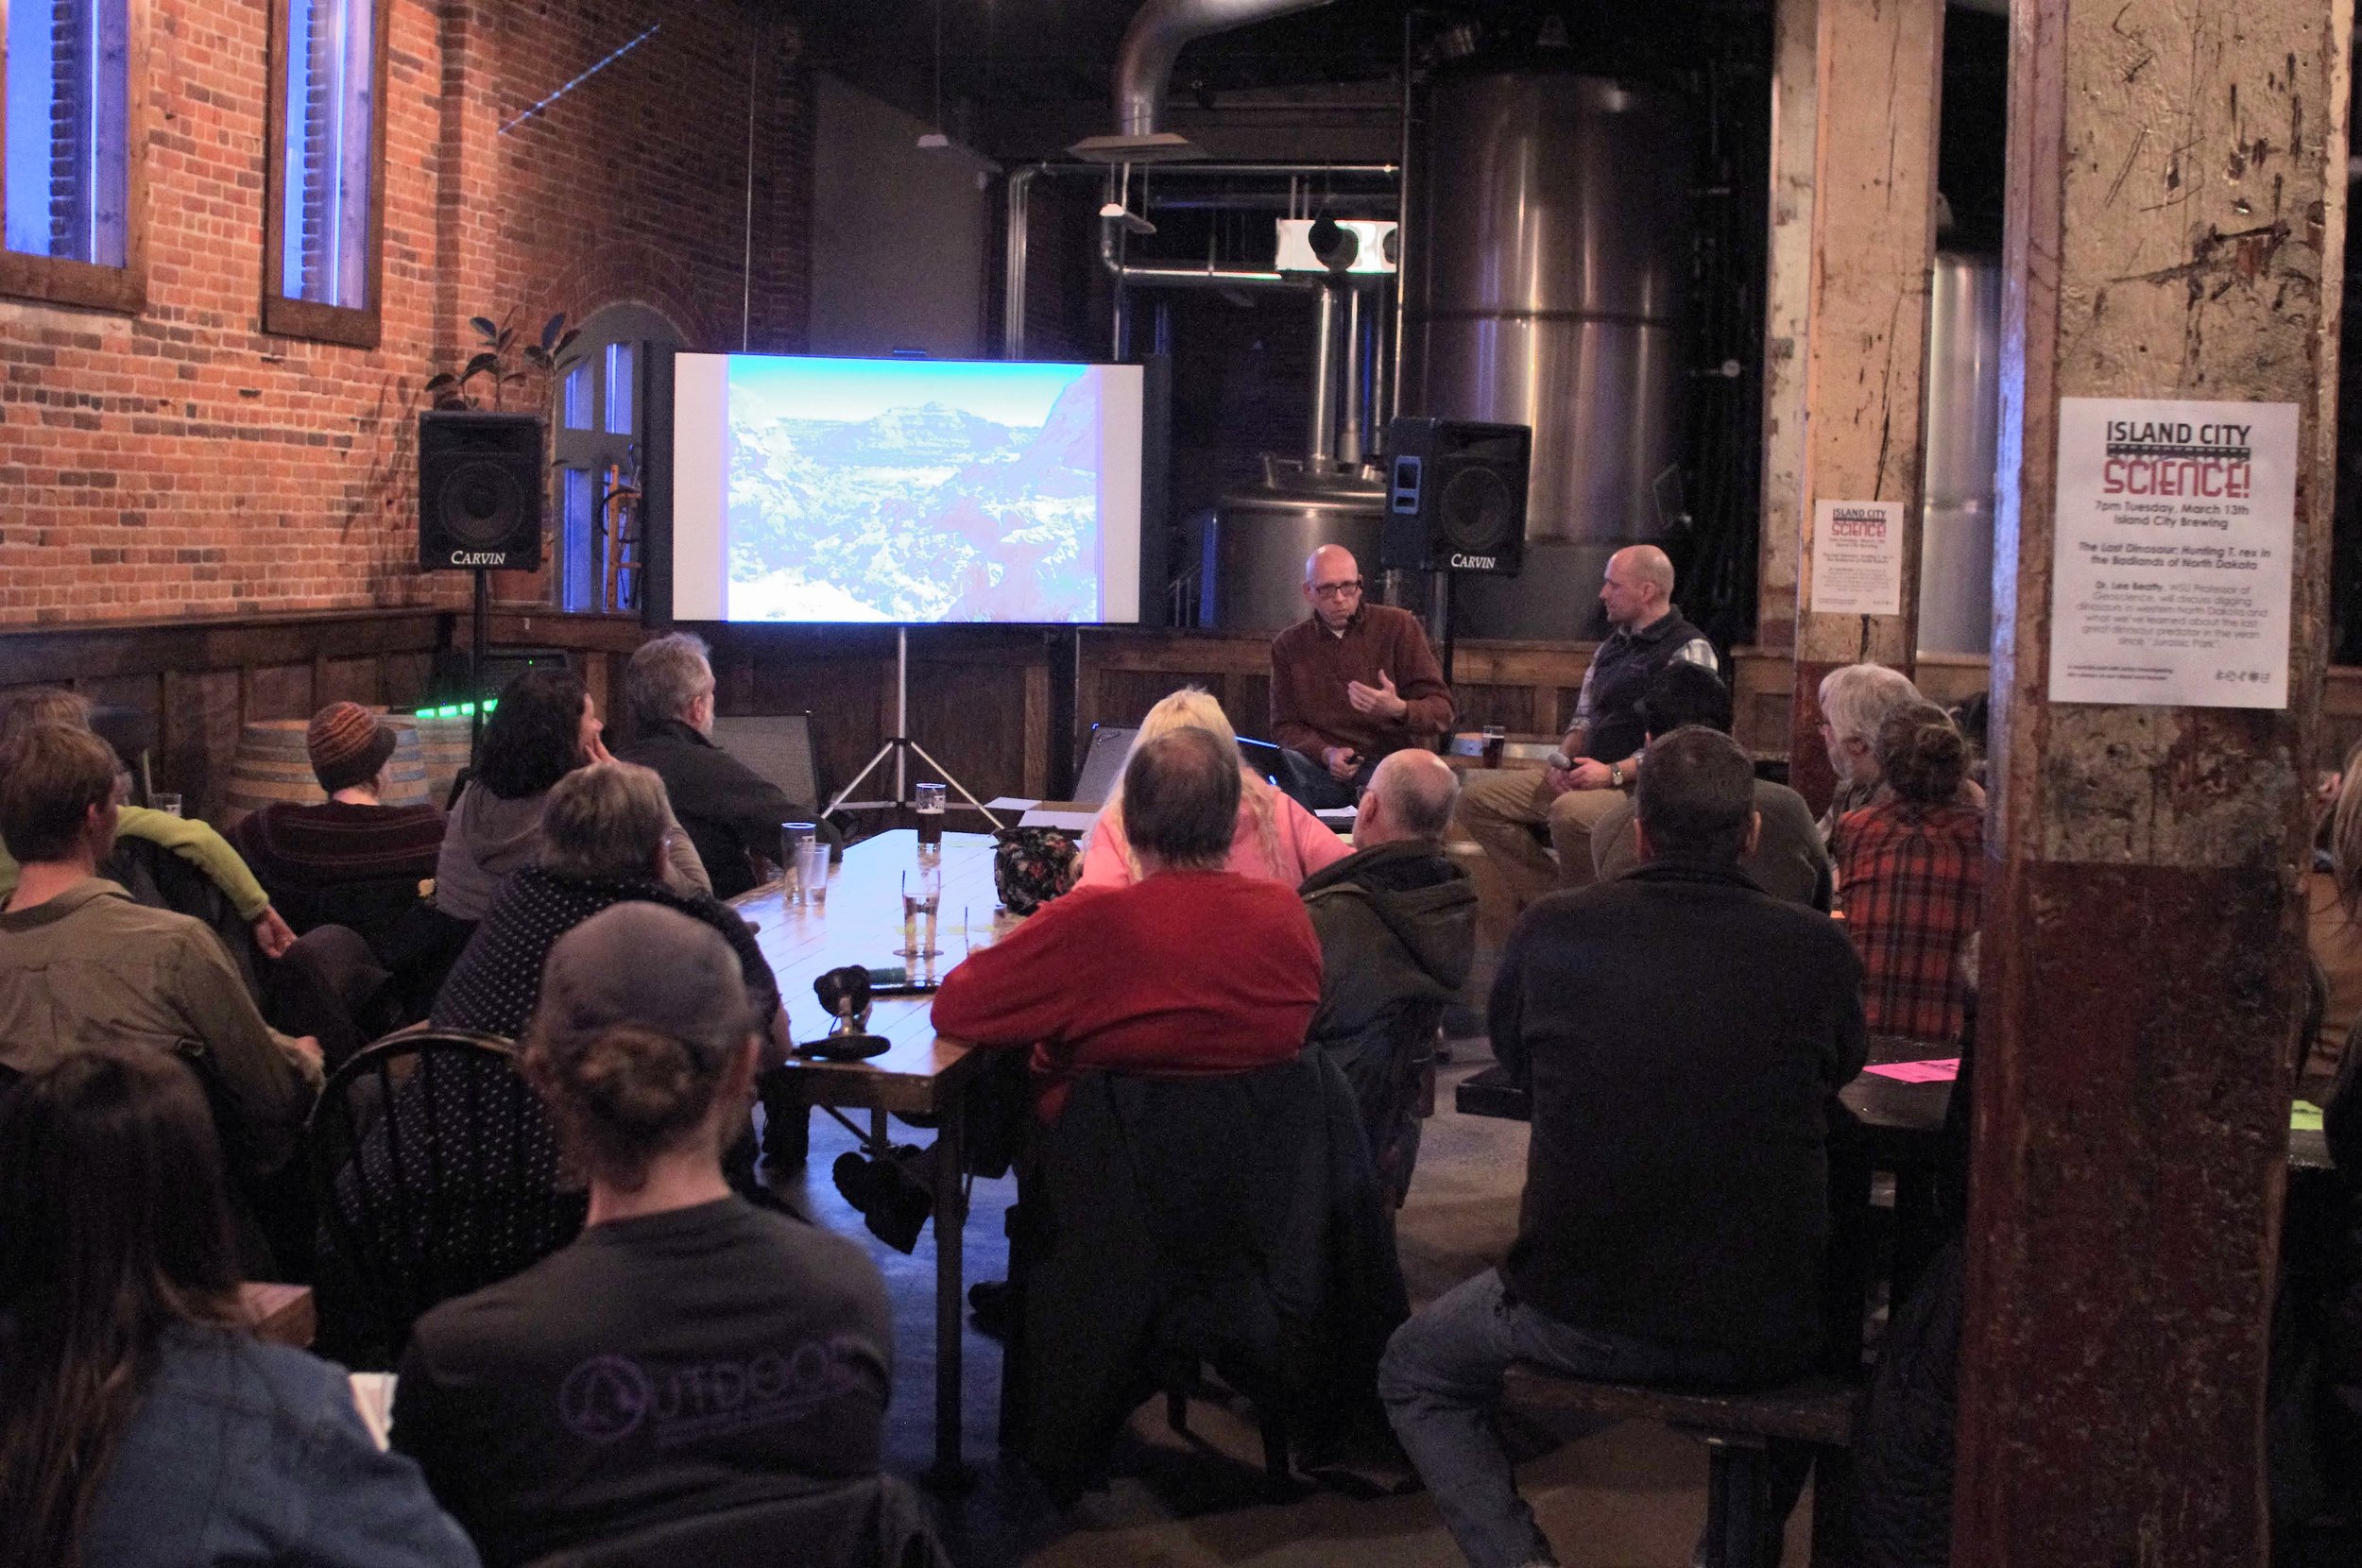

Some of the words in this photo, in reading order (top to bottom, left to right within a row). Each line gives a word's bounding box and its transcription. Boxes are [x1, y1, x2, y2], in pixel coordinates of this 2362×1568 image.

[2107, 421, 2192, 444] ISLAND
[2199, 423, 2251, 446] CITY
[2103, 459, 2251, 499] SCIENCE!
[1833, 508, 1865, 519] ISLAND
[1867, 510, 1886, 520] CITY
[2096, 500, 2122, 513] 7pm
[2182, 503, 2220, 515] March
[2224, 504, 2251, 516] 13th
[2114, 515, 2149, 525] Island
[2153, 516, 2177, 529] City
[2181, 517, 2228, 530] Brewing
[2080, 541, 2097, 552] The
[2100, 543, 2124, 553] Last
[2181, 546, 2225, 558] Hunting
[2239, 549, 2257, 558] rex
[2259, 549, 2272, 558] in
[2091, 555, 2108, 565] the
[2111, 555, 2165, 567] Badlands
[2167, 558, 2180, 567] of
[2182, 558, 2213, 568] North
[2216, 559, 2257, 570] Dakota
